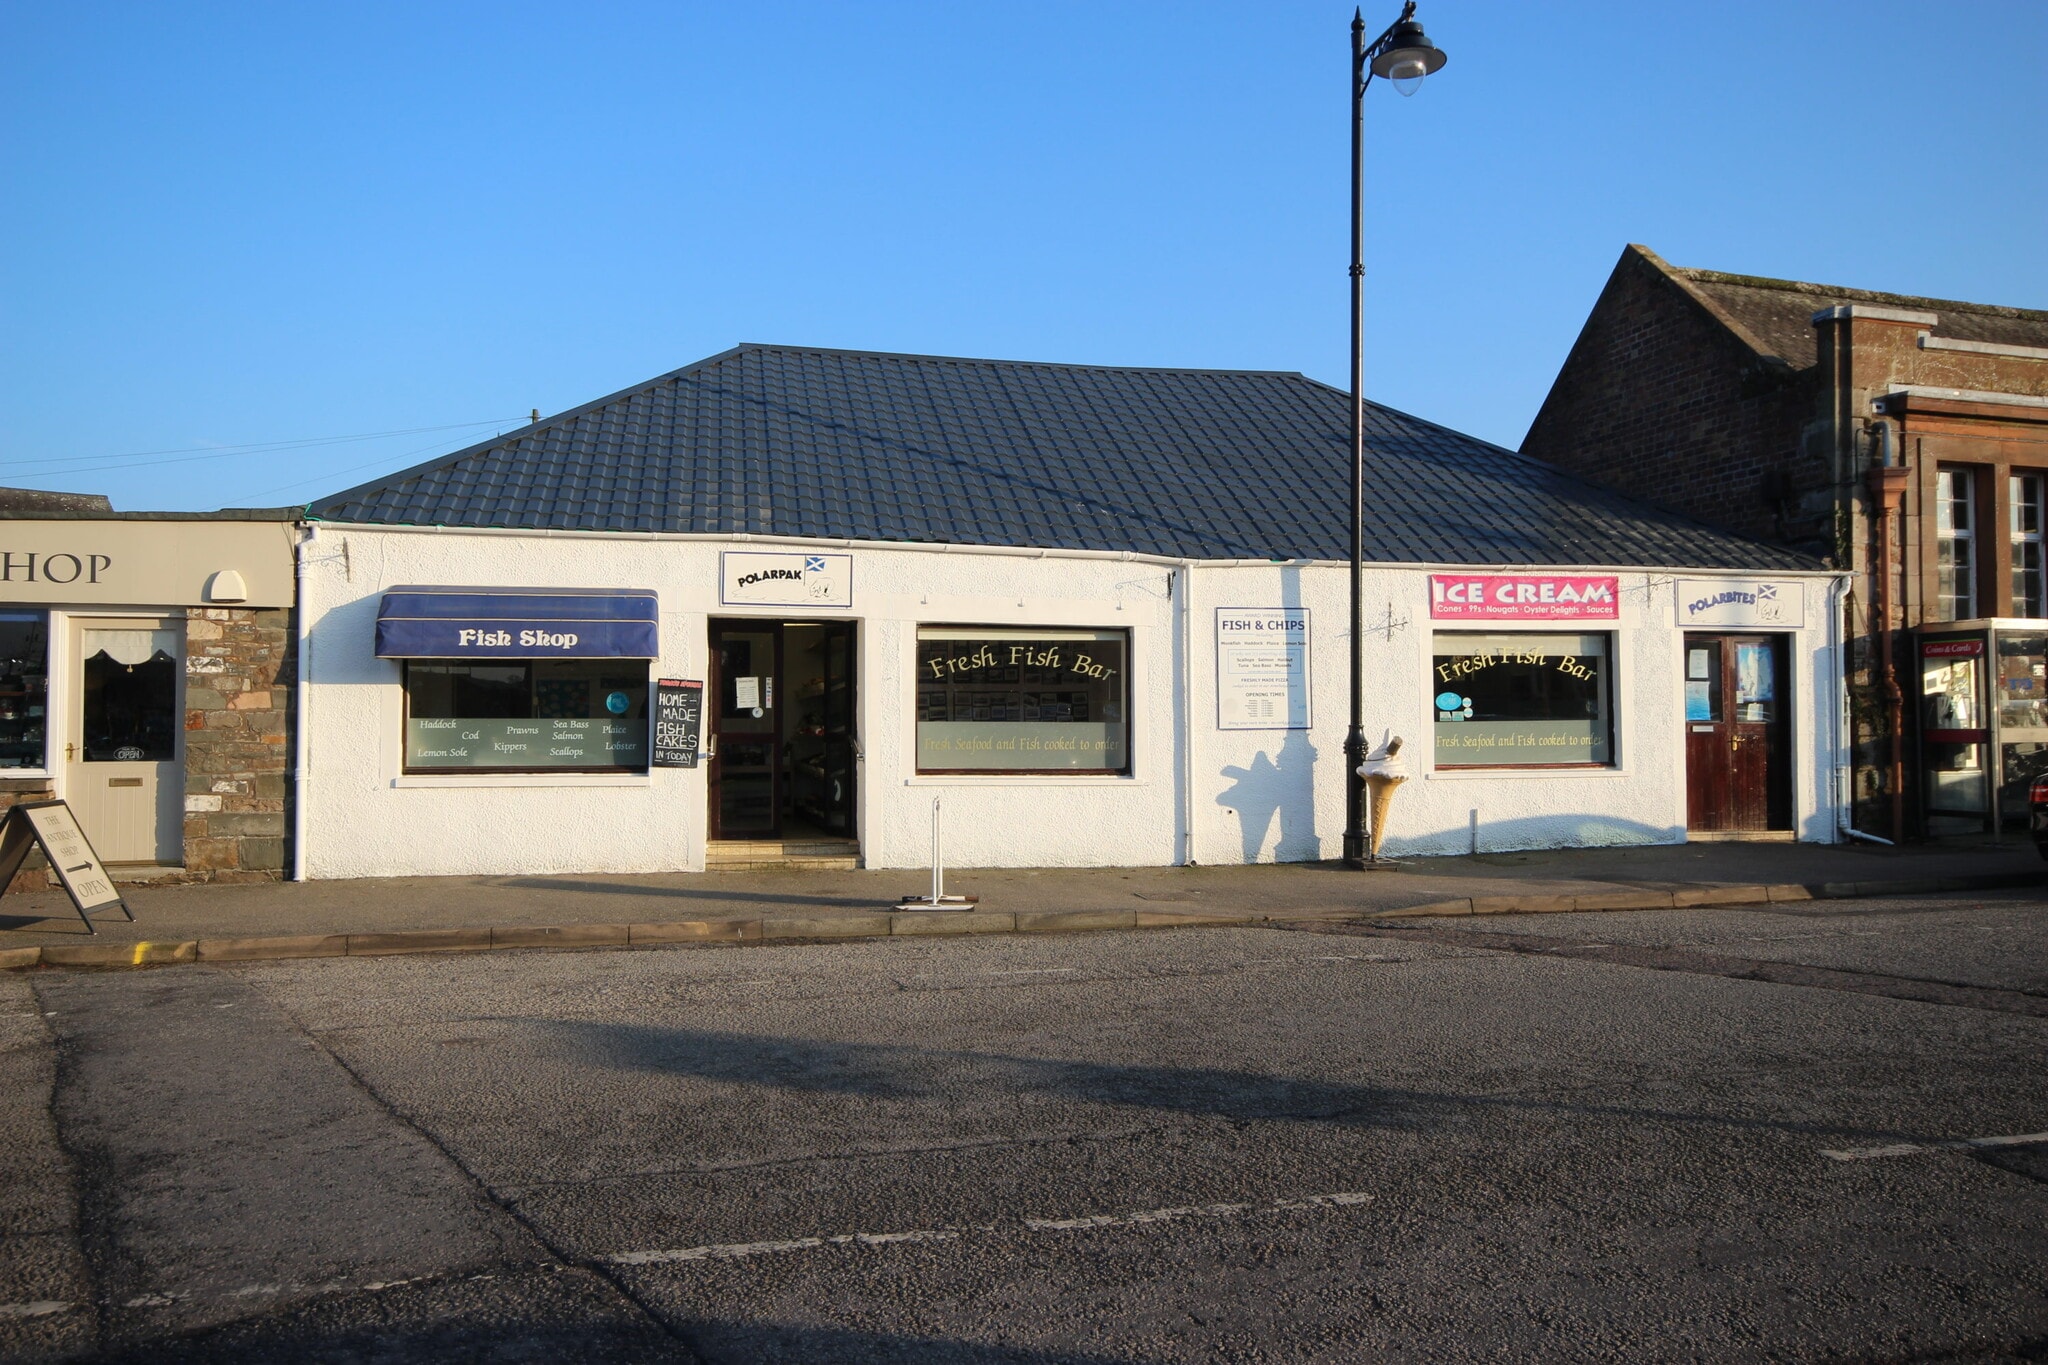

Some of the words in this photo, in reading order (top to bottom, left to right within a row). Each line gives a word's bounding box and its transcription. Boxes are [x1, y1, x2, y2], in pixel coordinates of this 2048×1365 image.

[737, 569, 802, 587] POLARPAK
[1436, 582, 1484, 603] ICE
[1496, 582, 1614, 604] CREAM
[1437, 604, 1462, 613] Cones
[1486, 605, 1519, 614] Nougats
[1523, 605, 1549, 615] Oyster
[1550, 605, 1580, 615] Delights
[1586, 605, 1613, 614] Sauces
[1688, 591, 1756, 615] POLARBITES
[1222, 620, 1251, 630] FISH
[1255, 620, 1264, 630] &
[1267, 620, 1305, 630] CHIPS
[458, 629, 511, 646] Fish
[520, 629, 578, 649] Shop
[928, 645, 997, 679] Fresh
[1009, 646, 1061, 668] Fish
[1071, 653, 1117, 681] Bar
[1435, 649, 1496, 682] Fresh
[1501, 646, 1547, 666] Fish
[1557, 655, 1597, 681] Bar
[662, 708, 697, 722] MADE
[420, 719, 457, 729] Haddock
[507, 726, 539, 735] Prawns
[553, 720, 568, 729] Sea
[570, 720, 589, 729] Bass
[602, 724, 627, 734] Plaice
[656, 722, 685, 736] FISH
[461, 730, 480, 740] Cod
[552, 730, 584, 740] Salmon
[655, 735, 698, 748] CAKES
[494, 742, 527, 753] Kippers
[605, 741, 637, 750] Lobster
[956, 735, 993, 755] Seafood
[996, 736, 1016, 750] and
[1020, 736, 1040, 750] Fish
[1044, 736, 1077, 750] cooked
[1080, 739, 1090, 750] to
[1094, 737, 1119, 750] order
[1436, 734, 1460, 747] Fresh
[1462, 733, 1496, 752] Seafood
[1498, 733, 1515, 747] and
[1517, 733, 1536, 746] Fish
[1539, 732, 1566, 746] cooked
[1569, 735, 1578, 746] to
[417, 748, 448, 757] Lemon
[449, 747, 468, 757] Sole
[550, 746, 583, 758] Scallops
[655, 751, 664, 759] IN
[665, 751, 693, 765] TODAY
[77, 878, 109, 898] OPEN
